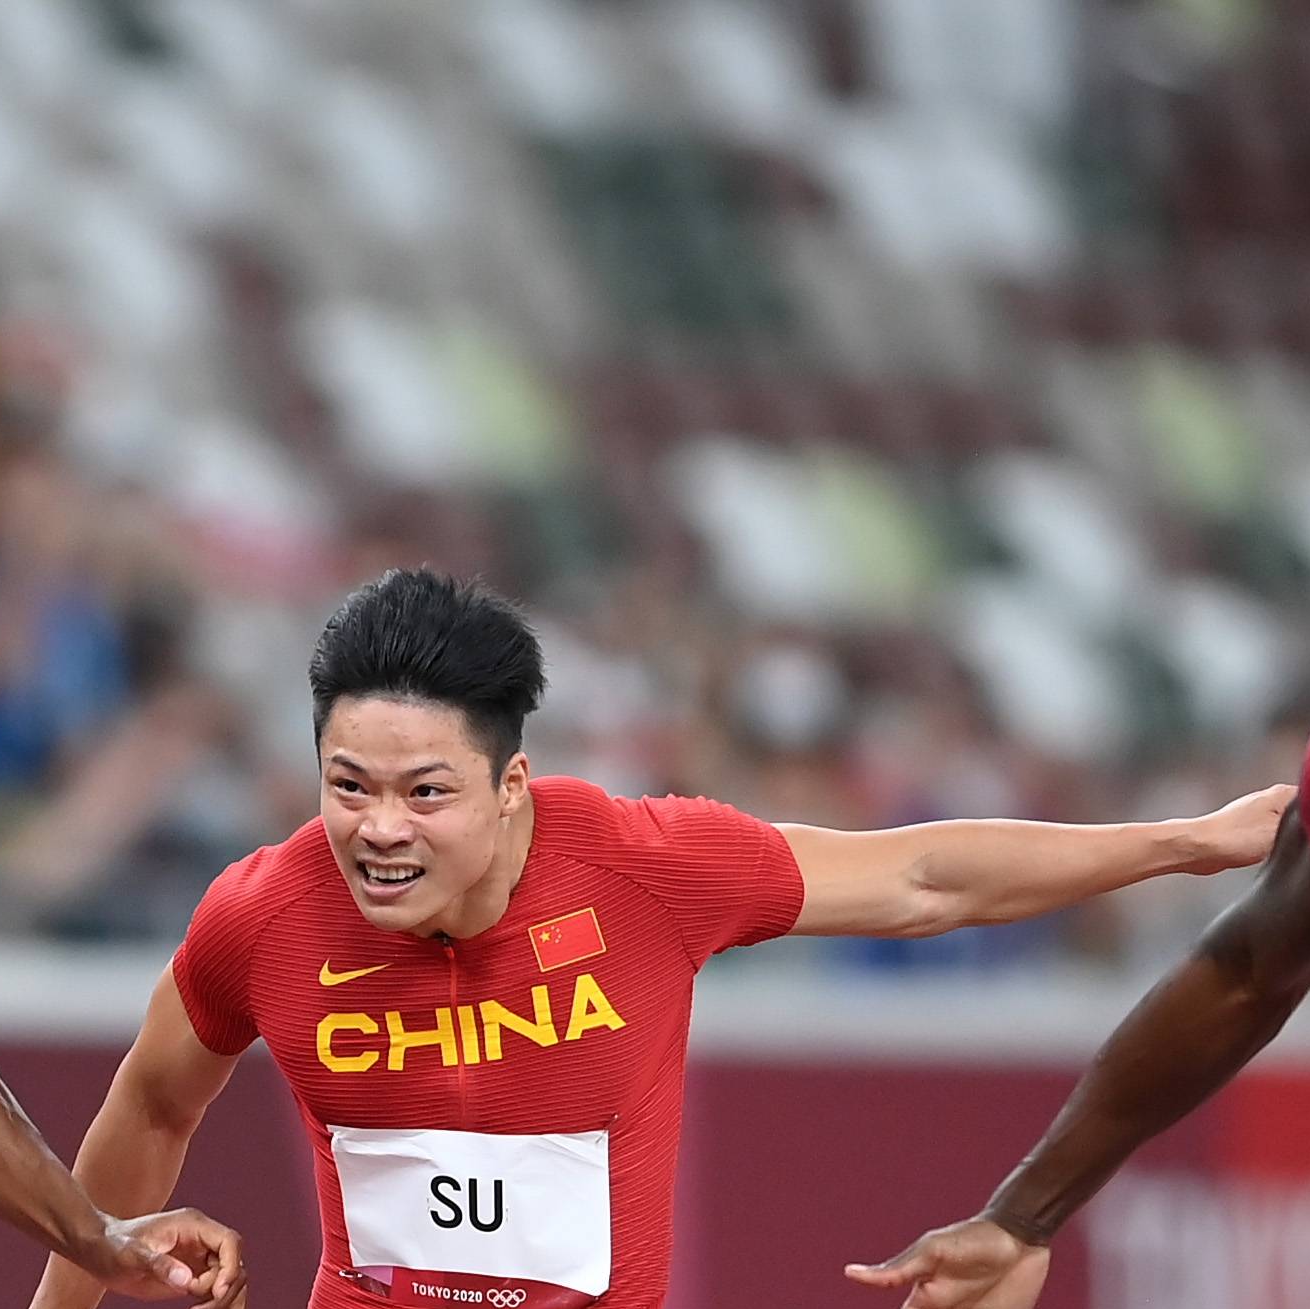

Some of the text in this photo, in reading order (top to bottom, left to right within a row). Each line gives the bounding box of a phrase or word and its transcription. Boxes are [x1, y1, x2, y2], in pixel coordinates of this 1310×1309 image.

[316, 972, 627, 1073] CHINA
[429, 1175, 504, 1232] SU
[411, 1282, 483, 1303] TOKYO 2020
